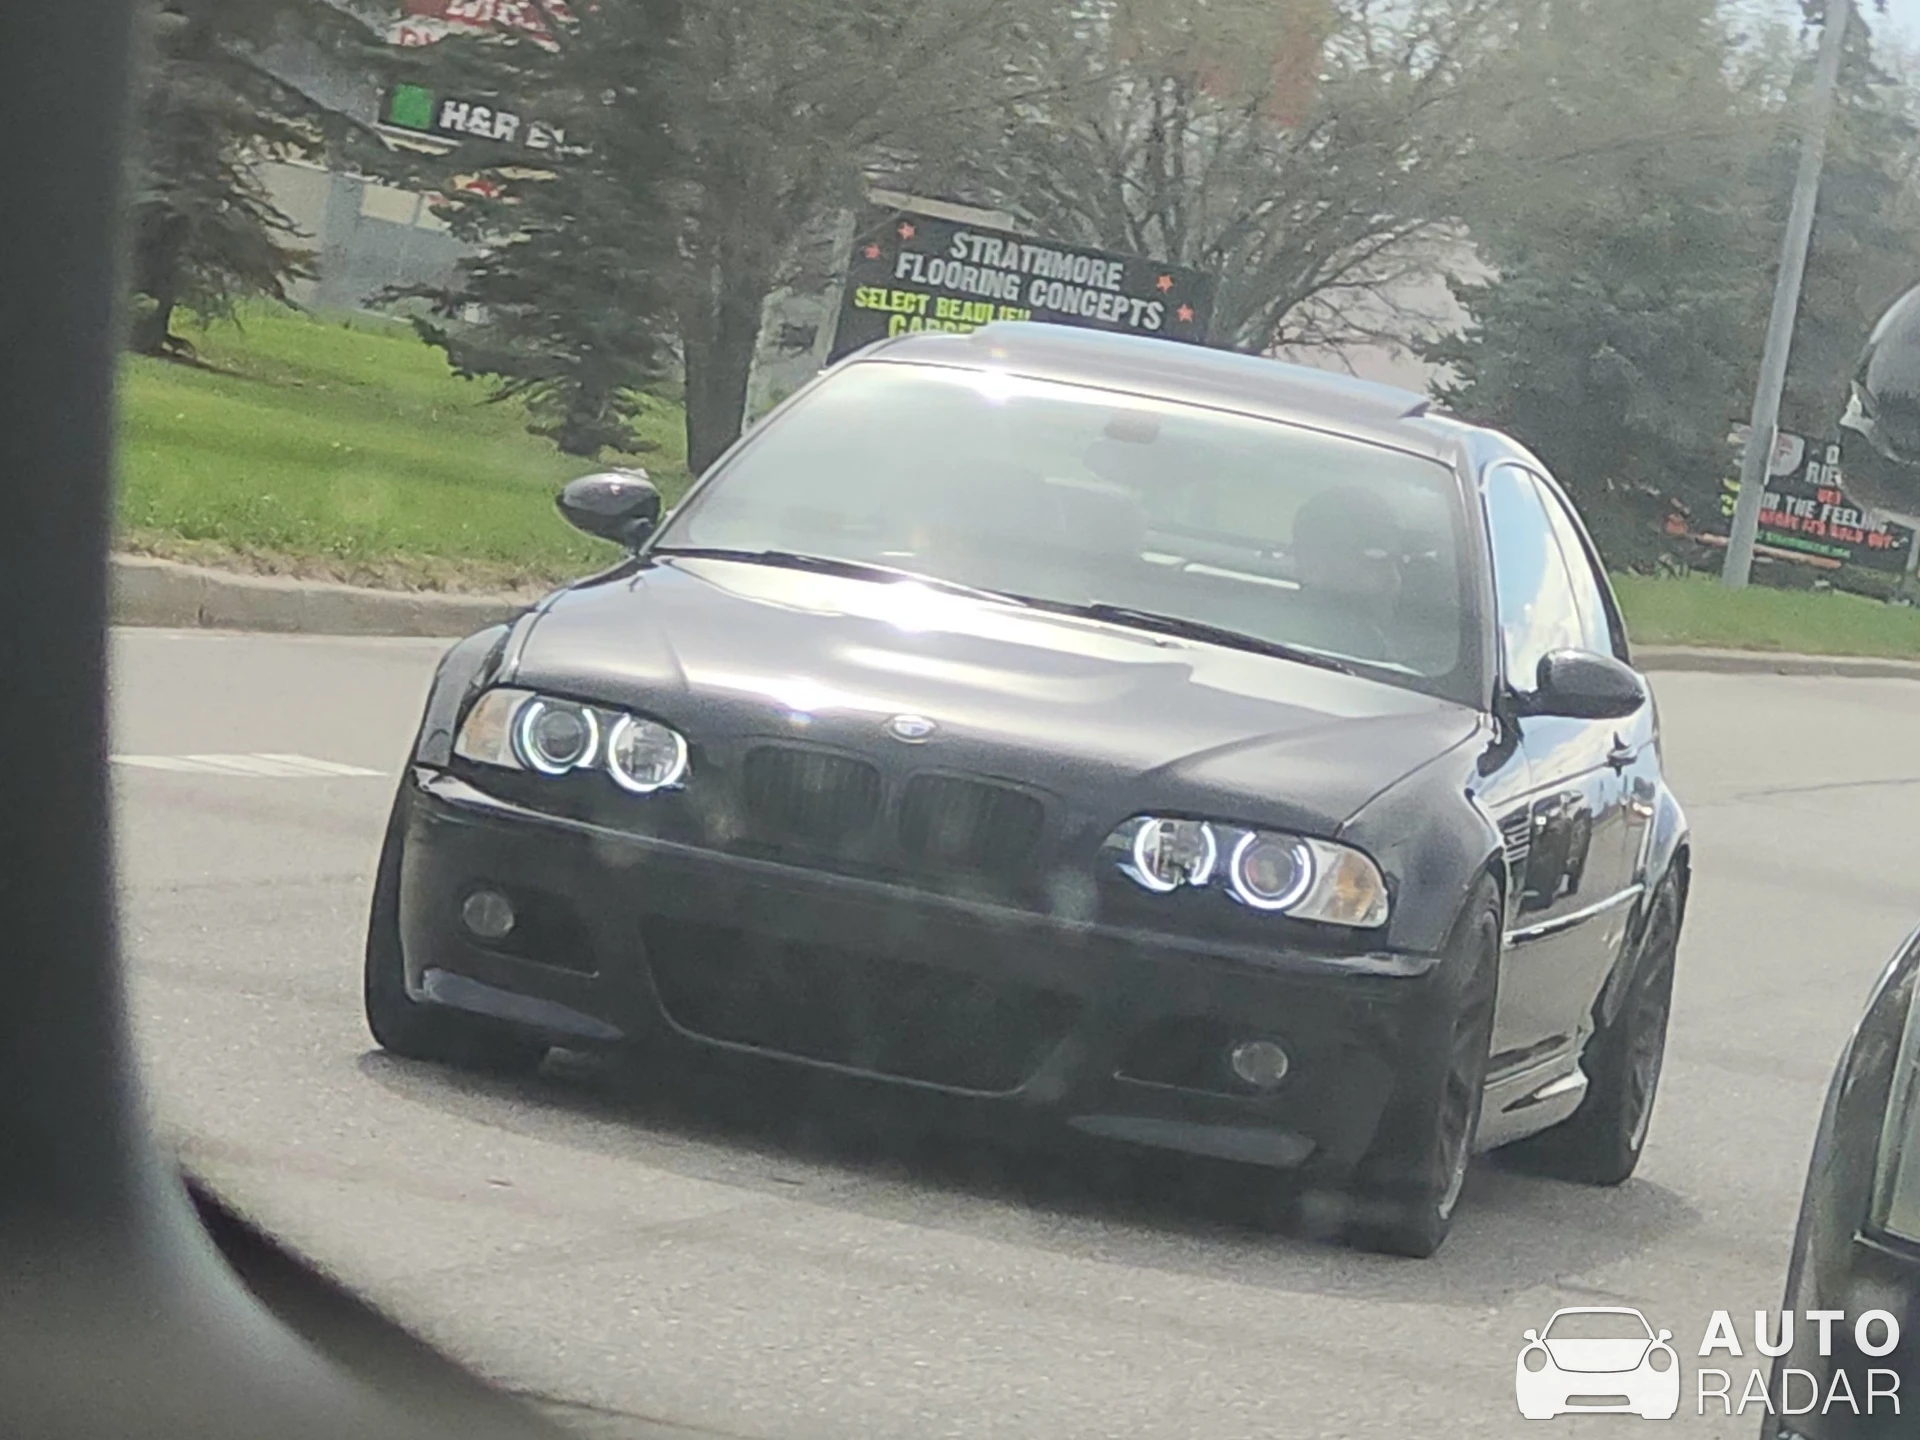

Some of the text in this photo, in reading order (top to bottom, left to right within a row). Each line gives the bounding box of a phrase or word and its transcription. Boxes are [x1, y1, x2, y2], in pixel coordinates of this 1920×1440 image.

[439, 100, 520, 142] H&R
[950, 231, 1124, 291] STRATHMORE
[853, 285, 931, 316] SELECT
[894, 251, 1164, 331] FLOORING CONCEPTS
[1785, 494, 1818, 519] THE
